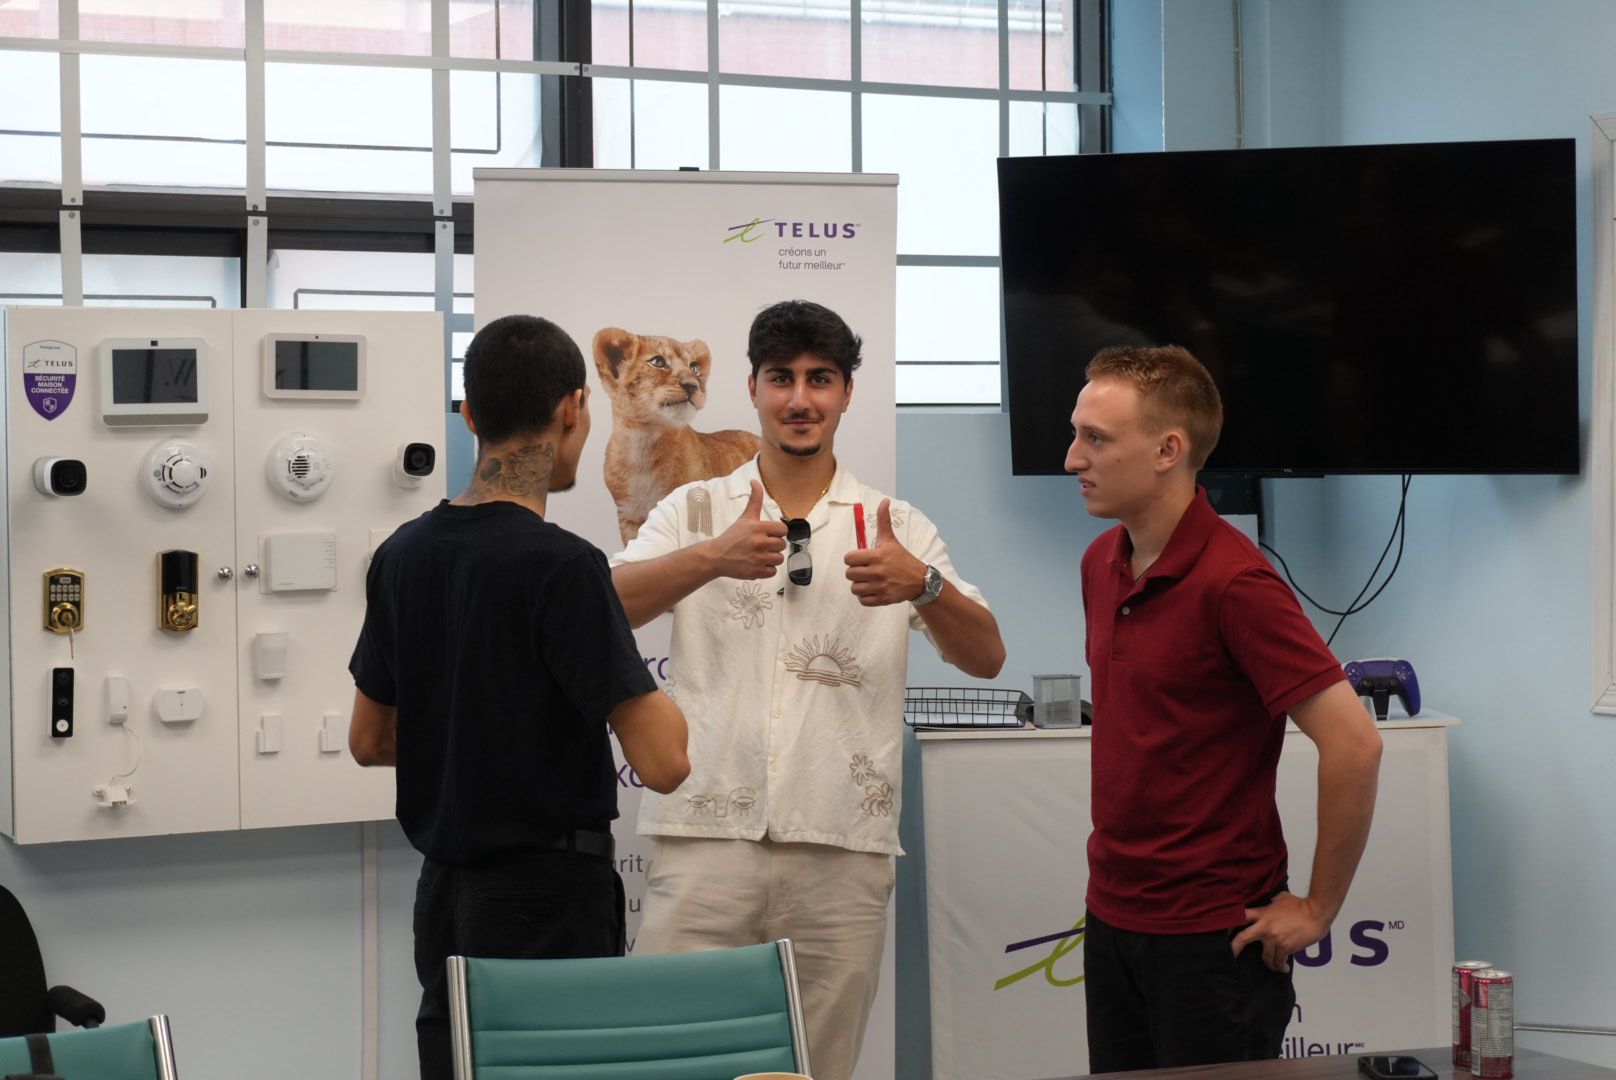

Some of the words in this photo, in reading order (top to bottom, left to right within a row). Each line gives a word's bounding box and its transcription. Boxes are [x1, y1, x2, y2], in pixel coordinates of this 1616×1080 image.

[774, 222, 856, 239] TELUS
[778, 246, 813, 257] créons
[814, 248, 827, 257] un
[778, 260, 802, 270] futur
[804, 260, 842, 271] meilleur
[615, 854, 644, 873] rit
